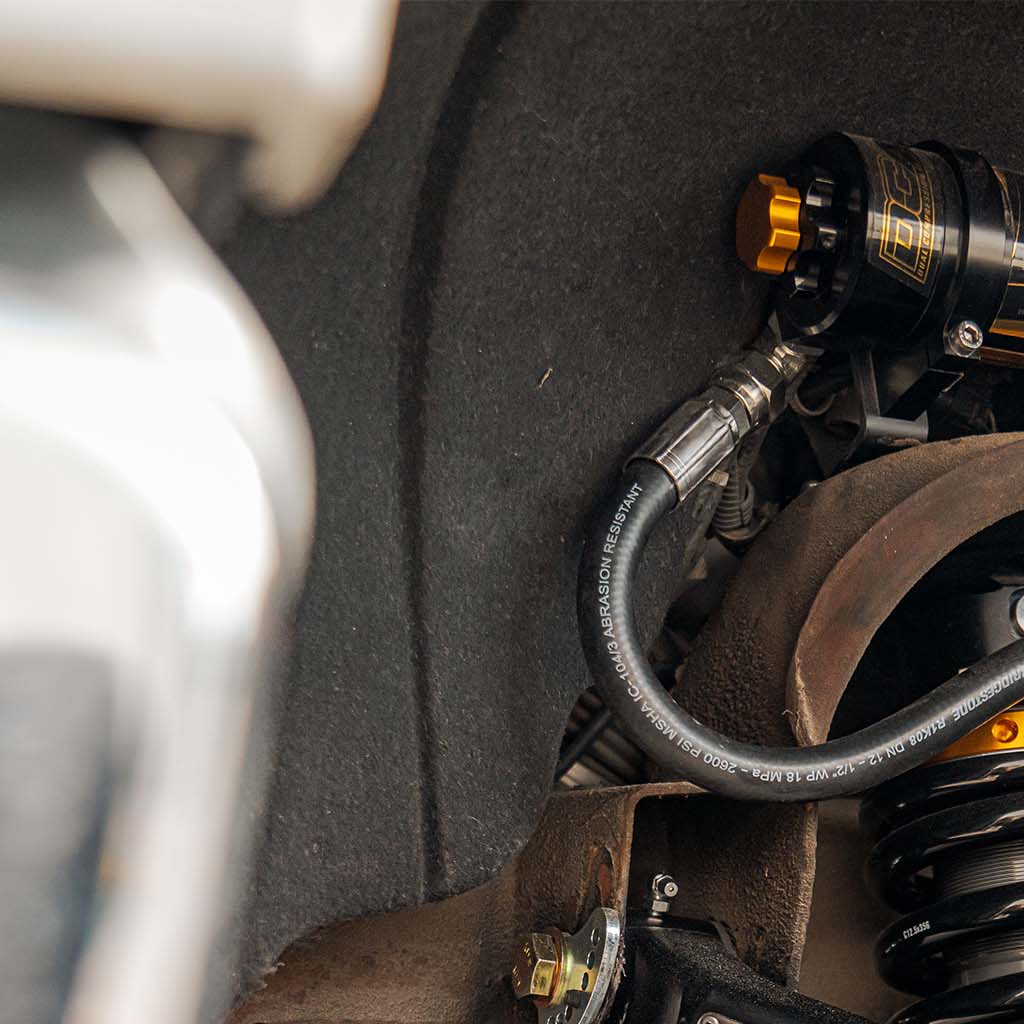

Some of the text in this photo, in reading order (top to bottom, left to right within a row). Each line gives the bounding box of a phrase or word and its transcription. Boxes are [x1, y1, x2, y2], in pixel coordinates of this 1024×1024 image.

[917, 249, 929, 277] DUAL
[604, 482, 644, 555] RESISTANT
[598, 557, 616, 639] ABRASION
[641, 702, 679, 741] MSHA
[909, 718, 947, 746] R1K08
[676, 735, 702, 759] PSI
[886, 744, 905, 760] DN
[703, 753, 738, 774] 2600
[868, 752, 884, 766] 12
[752, 767, 782, 782] MPa
[786, 769, 801, 782] 18
[806, 768, 830, 782] WP
